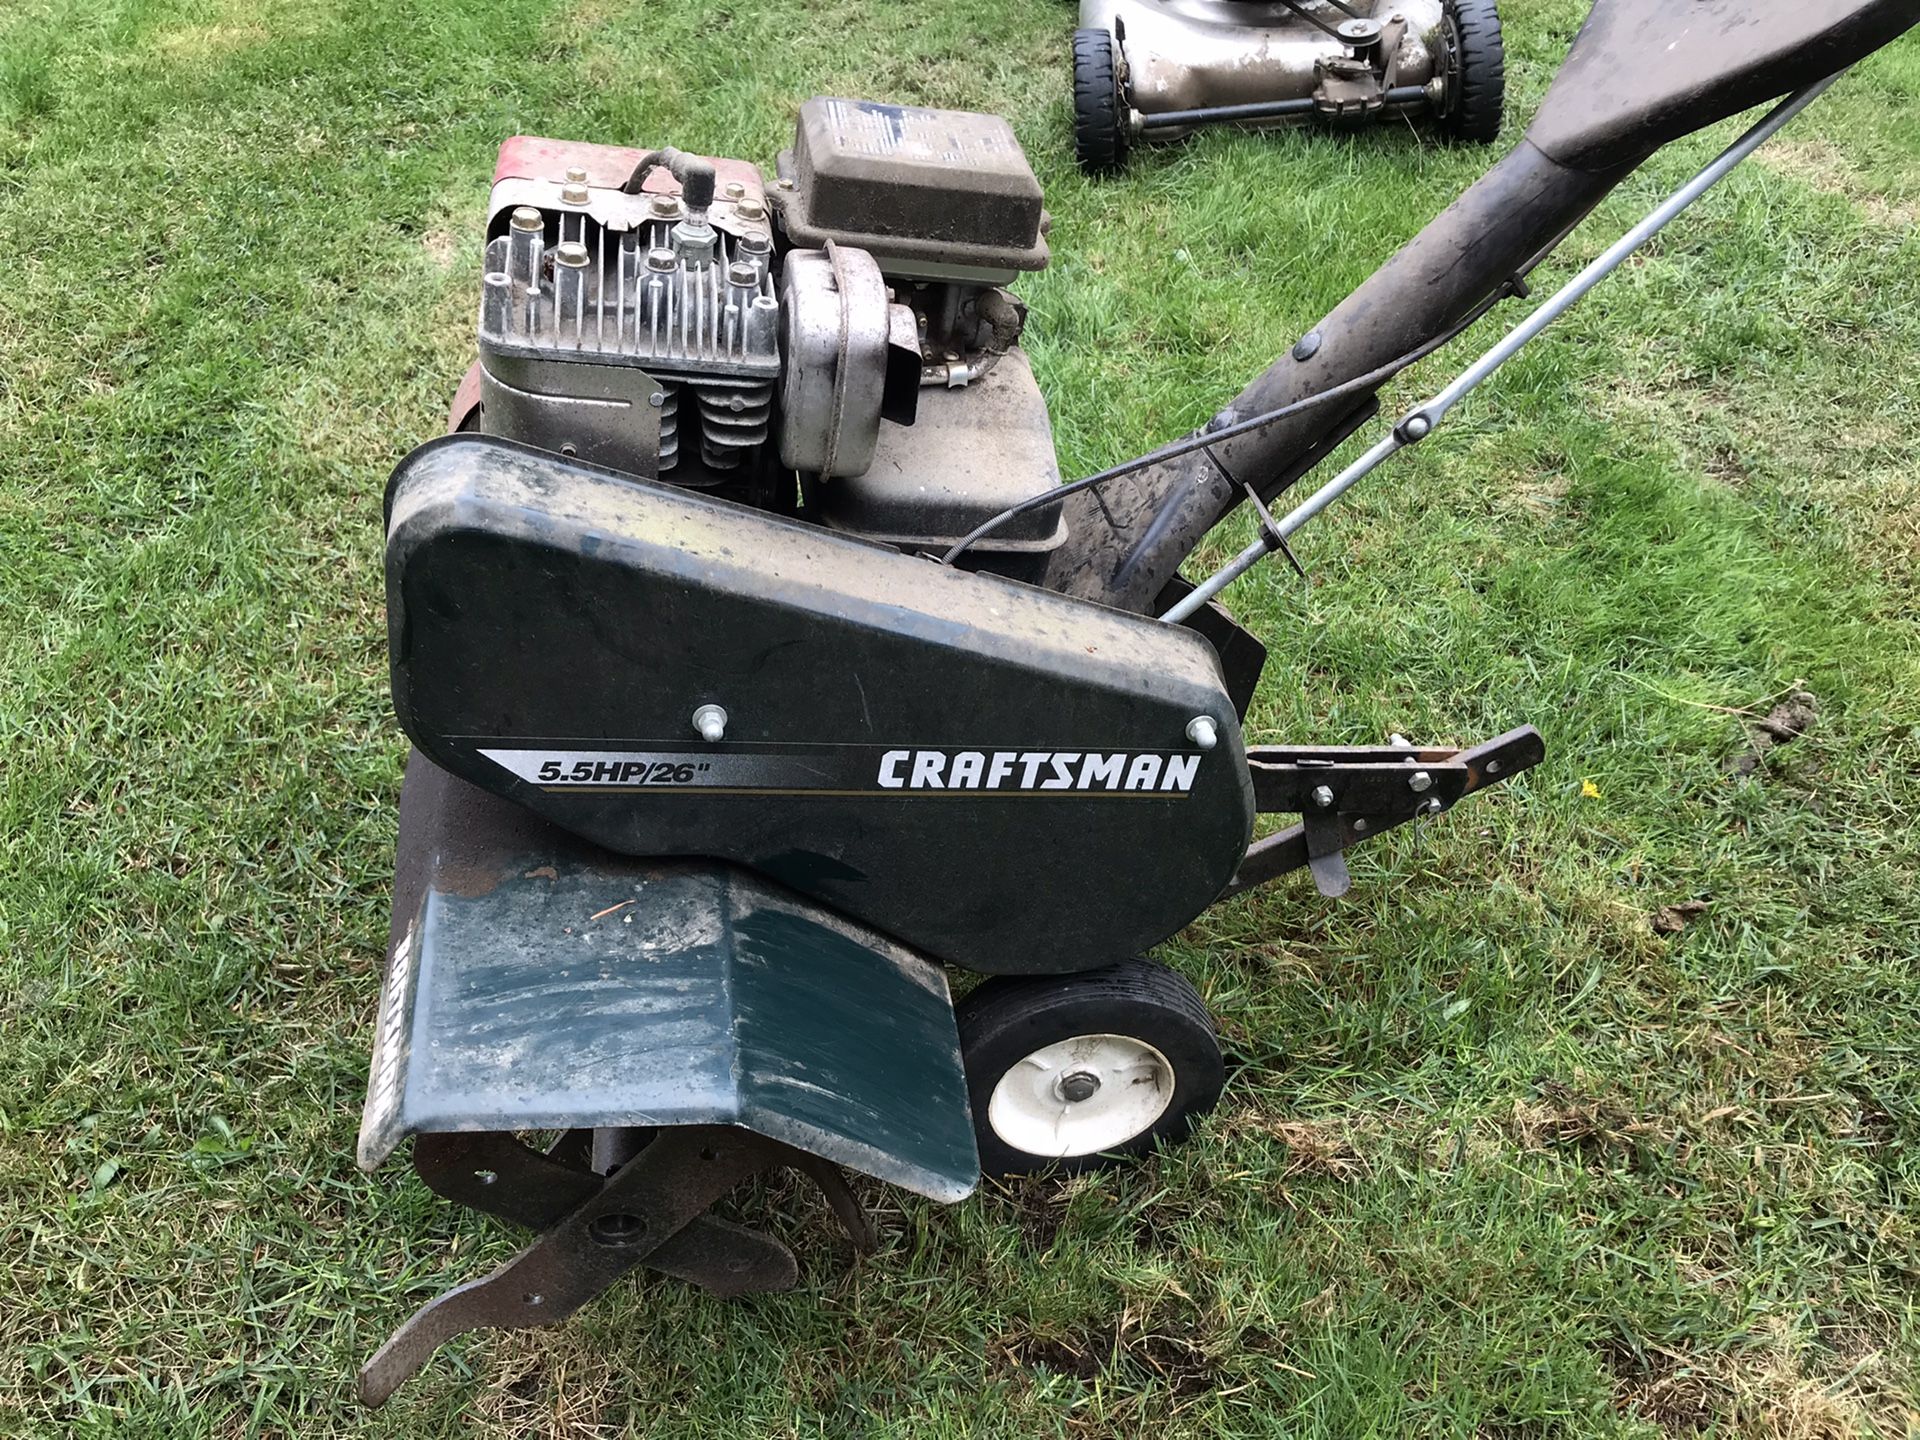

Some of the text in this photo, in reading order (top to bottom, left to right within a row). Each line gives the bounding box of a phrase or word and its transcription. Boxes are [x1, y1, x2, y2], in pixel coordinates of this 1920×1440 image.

[538, 750, 1201, 791] 5.5HP/26" CRAFTSMAN
[373, 919, 413, 1125] RAFTSMAN
